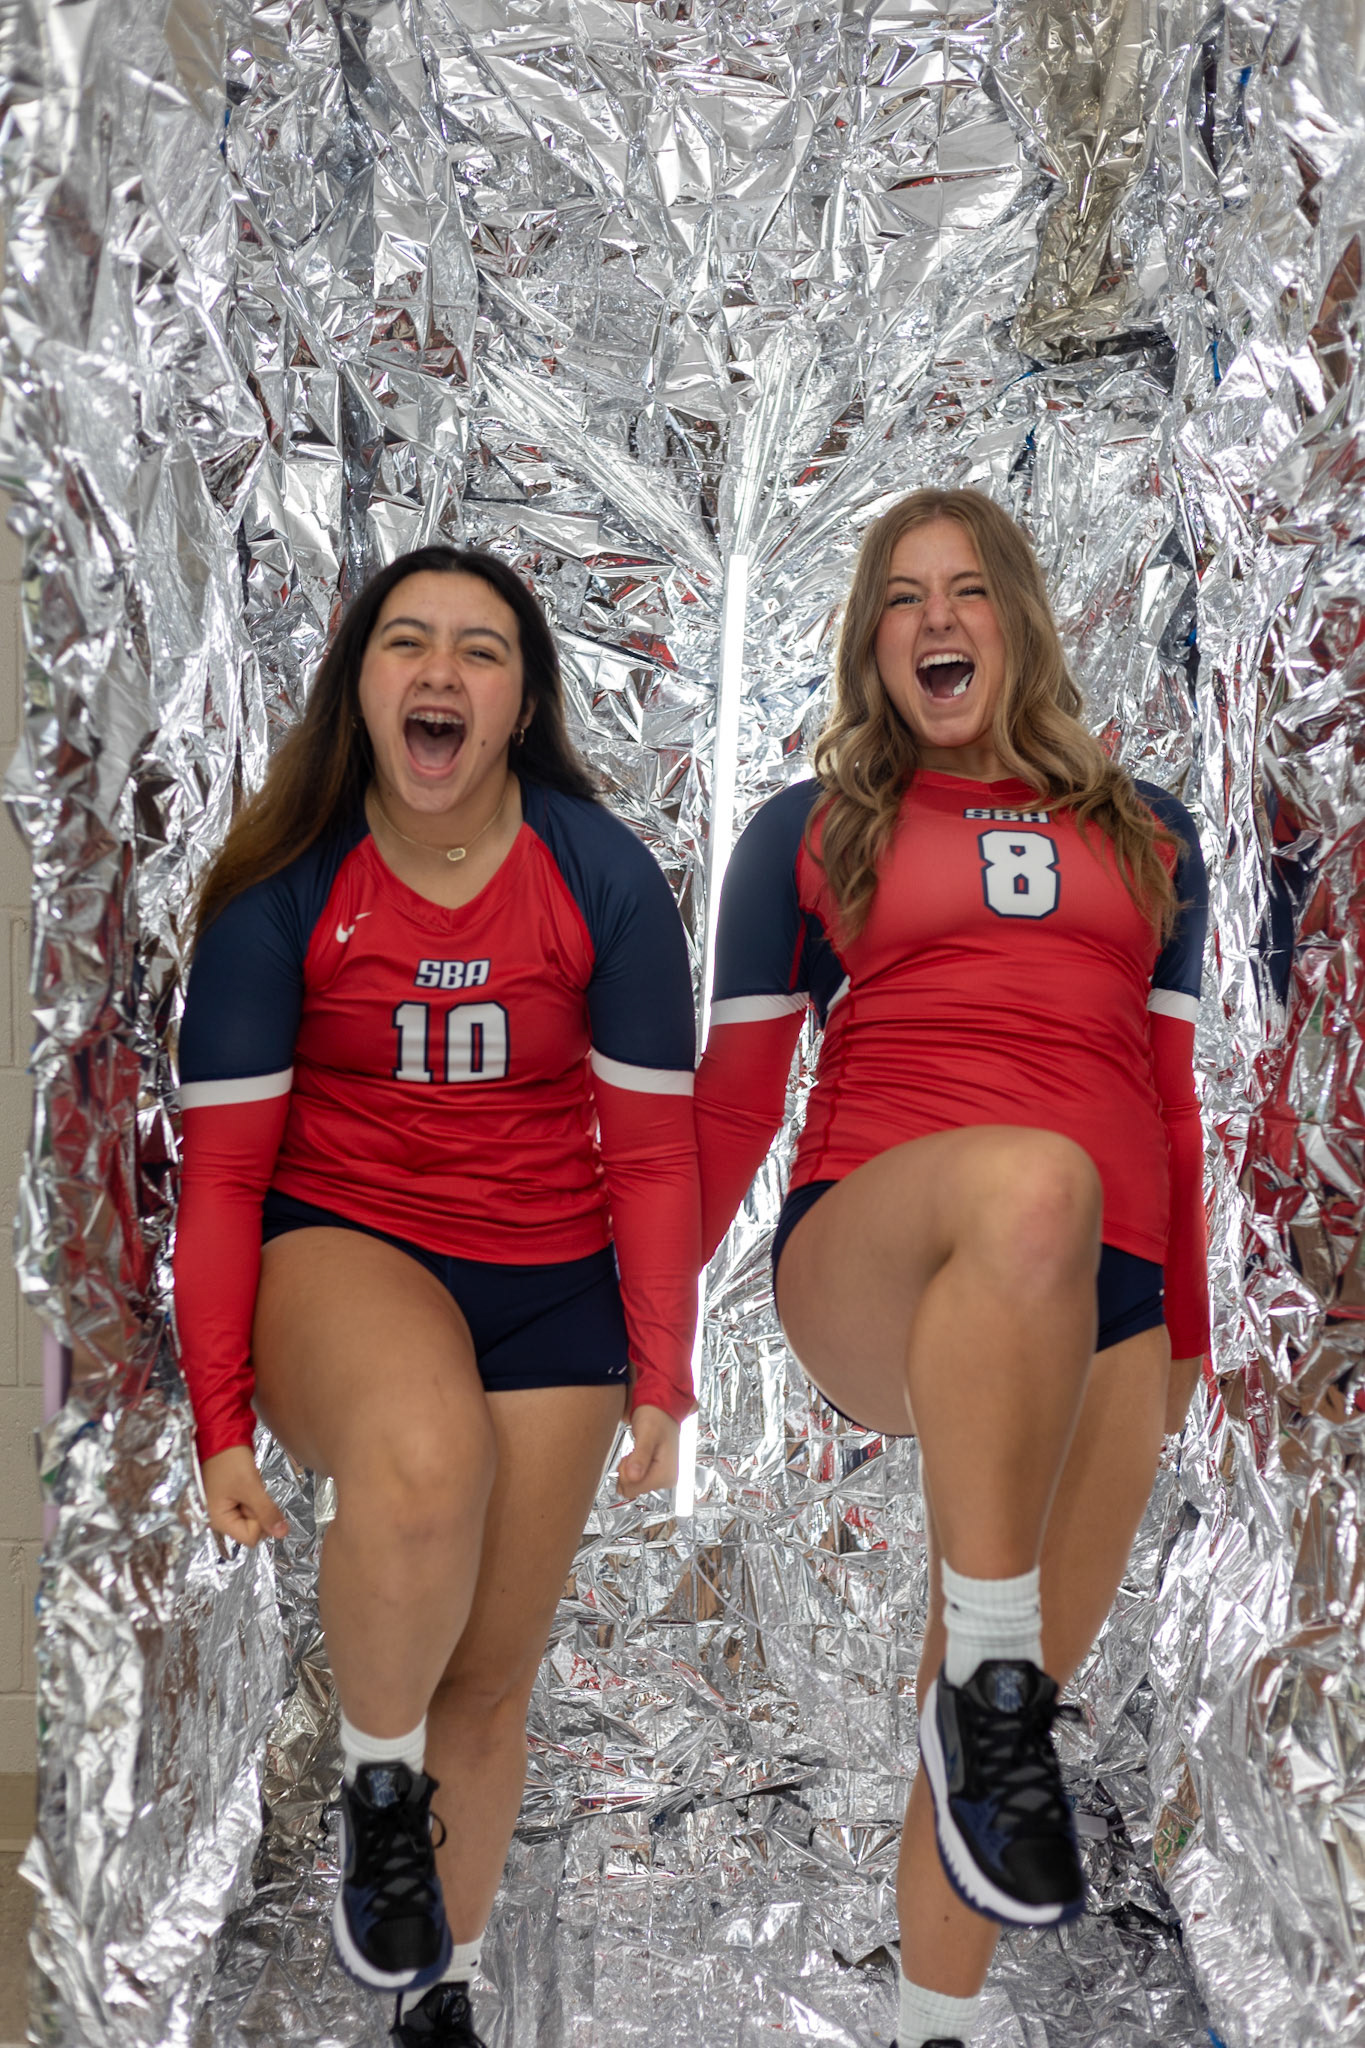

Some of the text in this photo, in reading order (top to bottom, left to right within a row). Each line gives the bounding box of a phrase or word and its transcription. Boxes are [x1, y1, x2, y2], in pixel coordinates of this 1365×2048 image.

[963, 808, 1050, 824] SBA
[977, 829, 1060, 920] 8
[413, 958, 491, 990] SBA
[392, 1000, 511, 1084] 10
